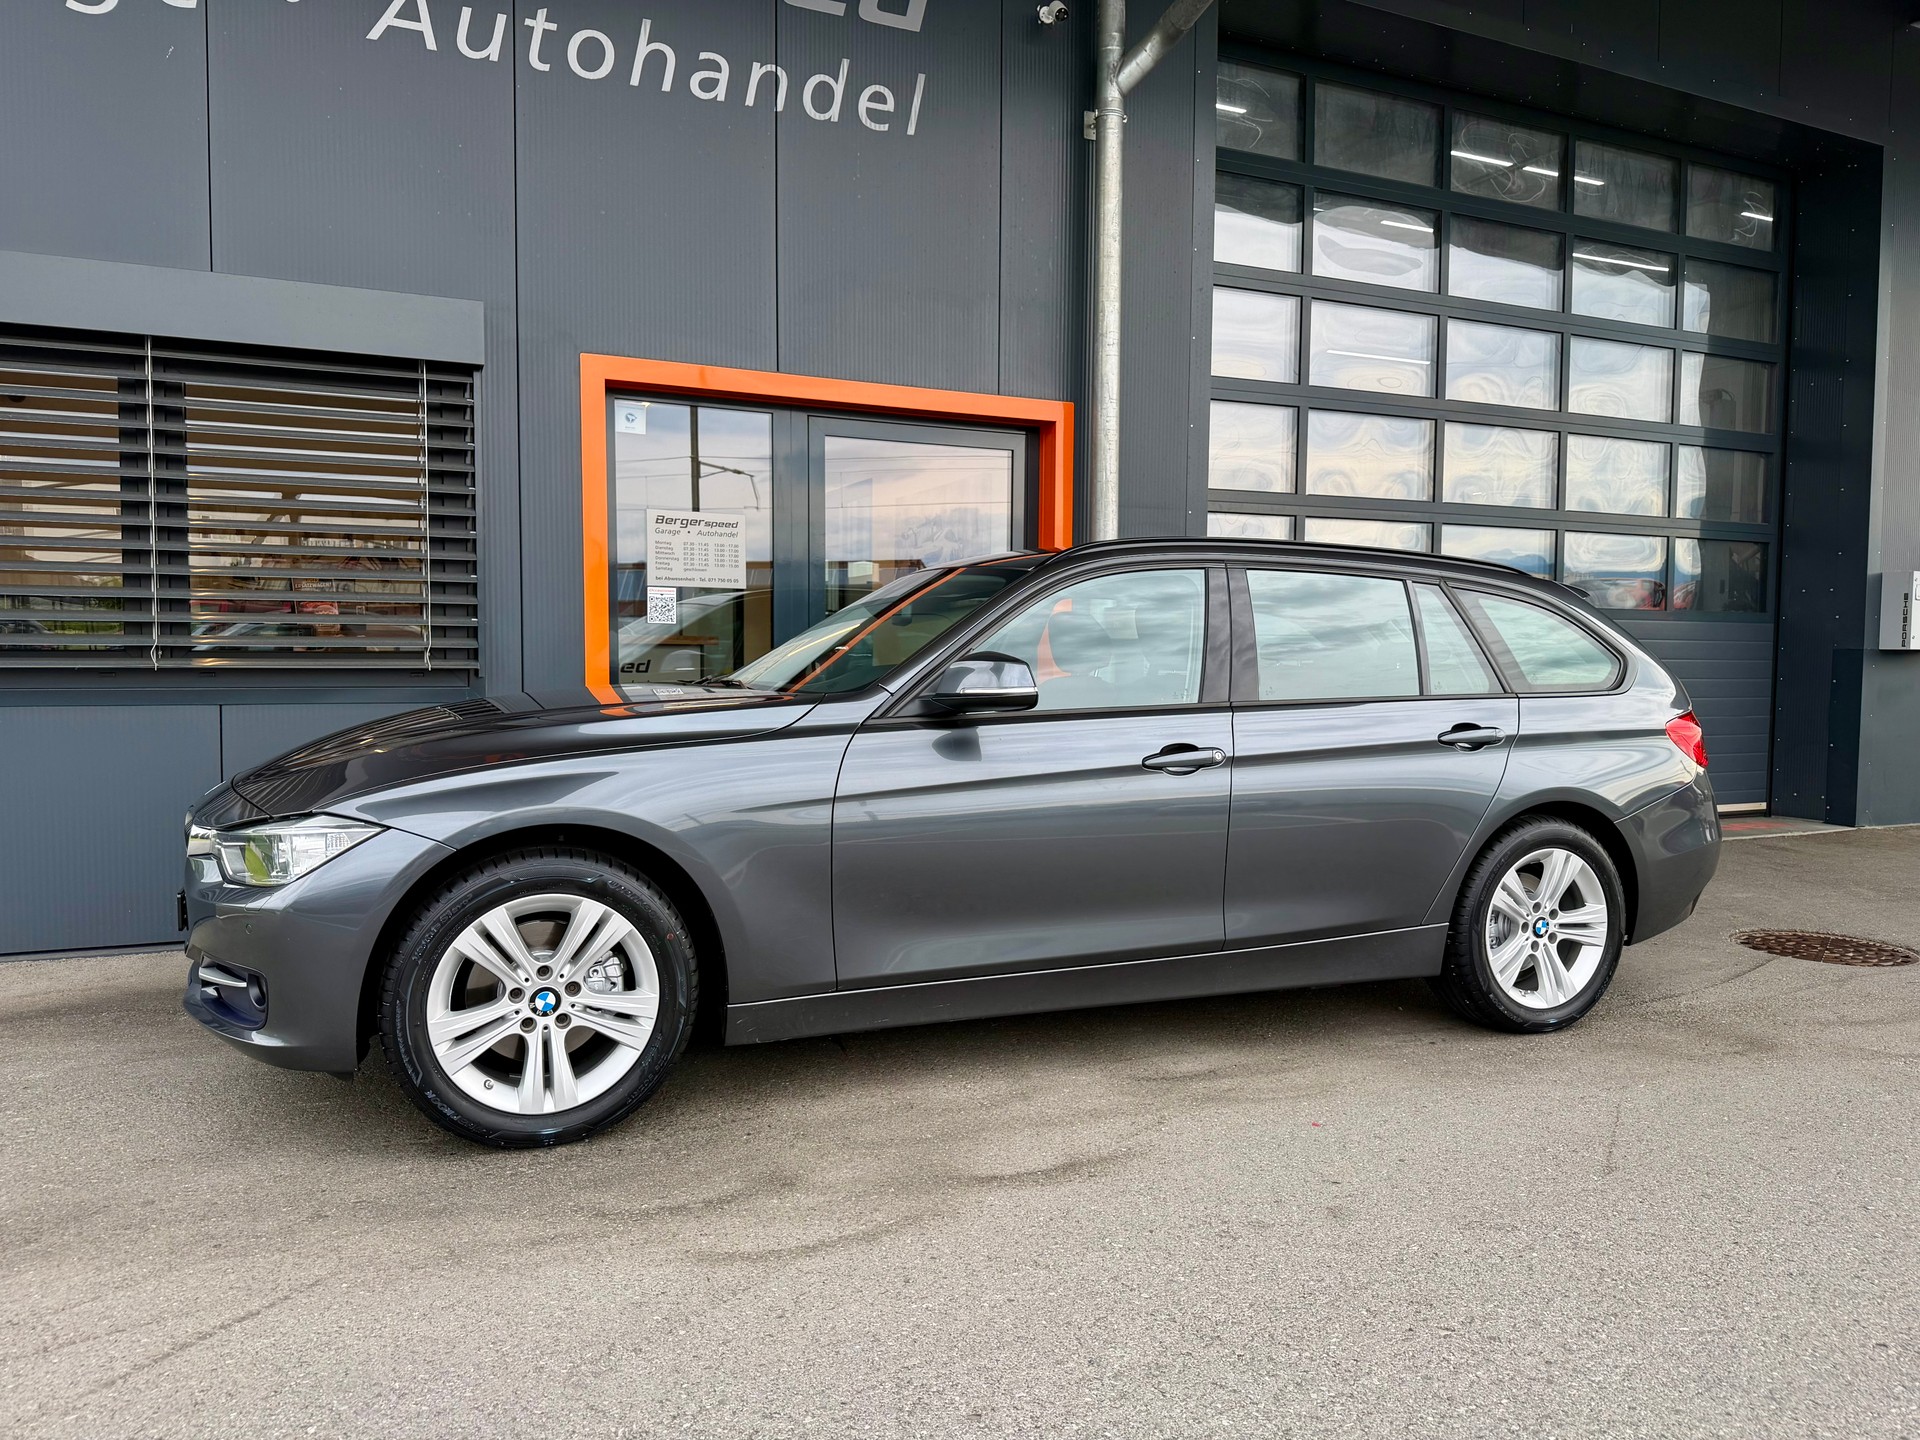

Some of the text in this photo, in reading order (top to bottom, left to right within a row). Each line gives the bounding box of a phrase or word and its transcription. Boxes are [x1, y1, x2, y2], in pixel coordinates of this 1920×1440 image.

[366, 0, 926, 135] Autohandel
[655, 514, 739, 528] Bergerspeed
[654, 527, 738, 538] Garage Autohandel
